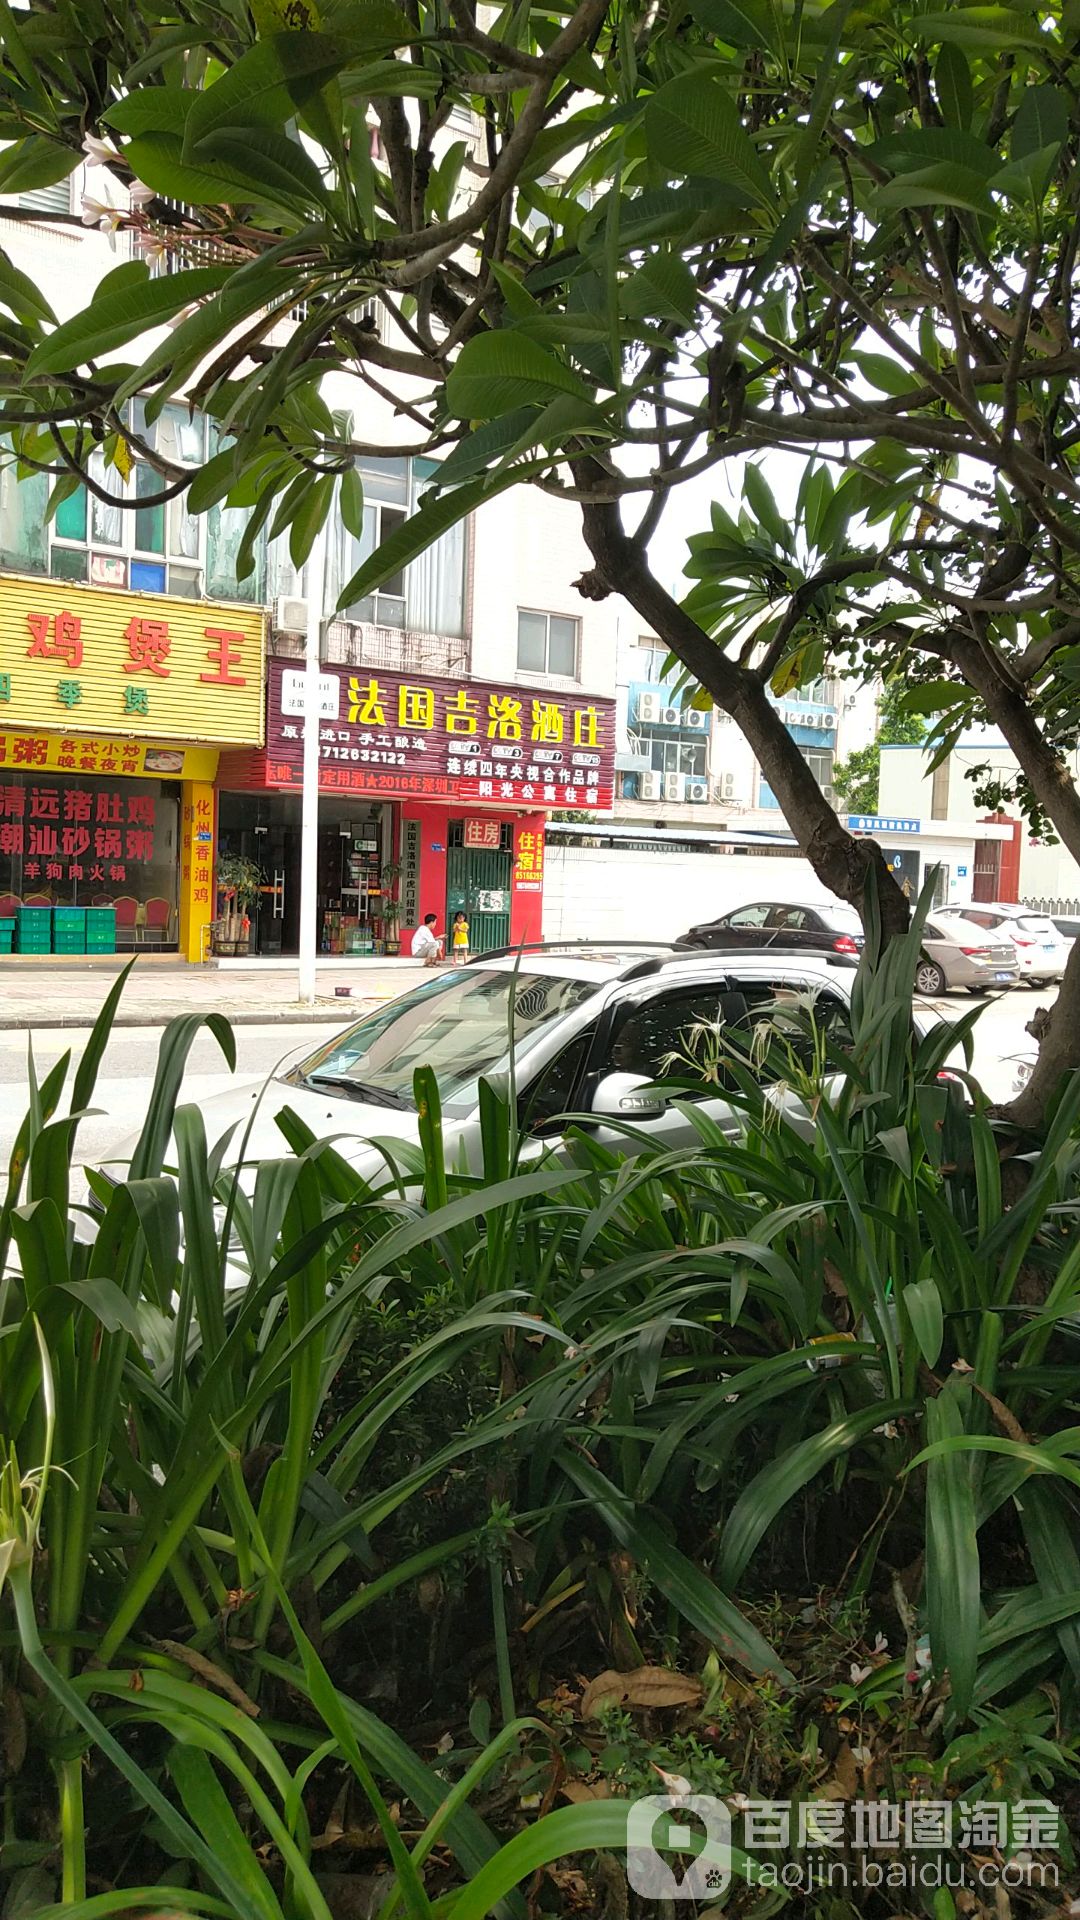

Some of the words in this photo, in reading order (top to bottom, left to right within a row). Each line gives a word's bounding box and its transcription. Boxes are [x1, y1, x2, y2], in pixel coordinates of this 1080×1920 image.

[27, 611, 246, 685] 鸡煲王
[348, 677, 605, 748] 法国吉洛酒庄
[0, 736, 48, 765] 粥
[59, 739, 141, 758] 各式小炒
[57, 755, 139, 773] 晚餐夜宵
[447, 757, 600, 786] 连续四年央视合作品牌
[0, 784, 157, 826] 清远猪肚鸡
[0, 822, 154, 861] 潮汕砂锅粥
[467, 821, 499, 843] 住房
[518, 831, 536, 870] 住宿
[24, 862, 127, 882] 羊狗肉火锅
